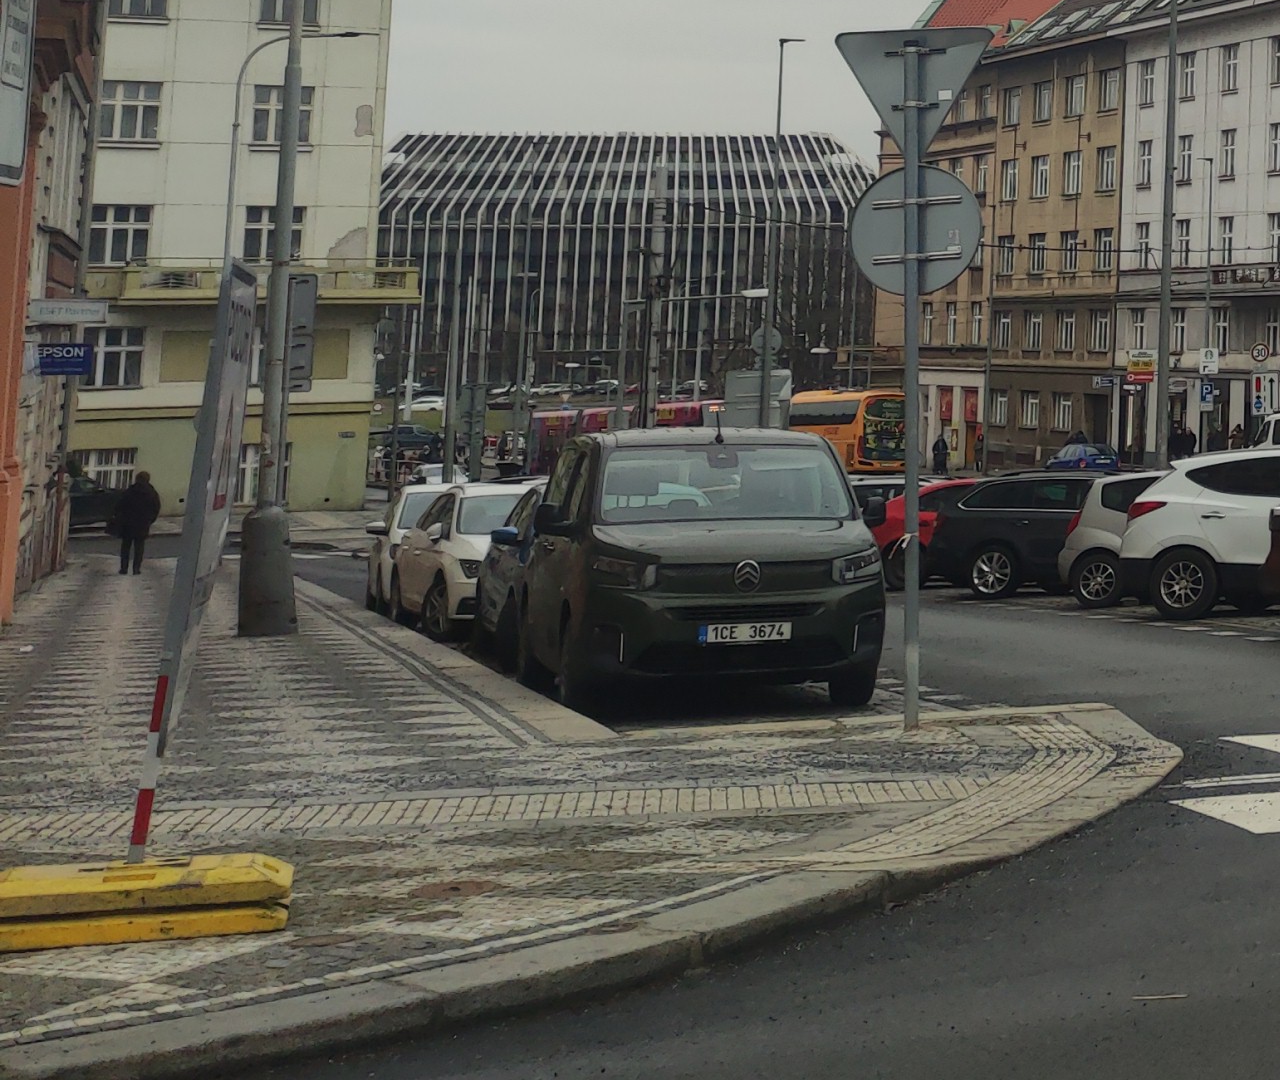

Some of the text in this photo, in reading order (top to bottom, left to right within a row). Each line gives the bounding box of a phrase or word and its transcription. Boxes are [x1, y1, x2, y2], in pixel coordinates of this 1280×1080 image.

[38, 346, 84, 358] EPSON
[1254, 347, 1266, 358] 30
[711, 623, 784, 640] 1CE 3674
